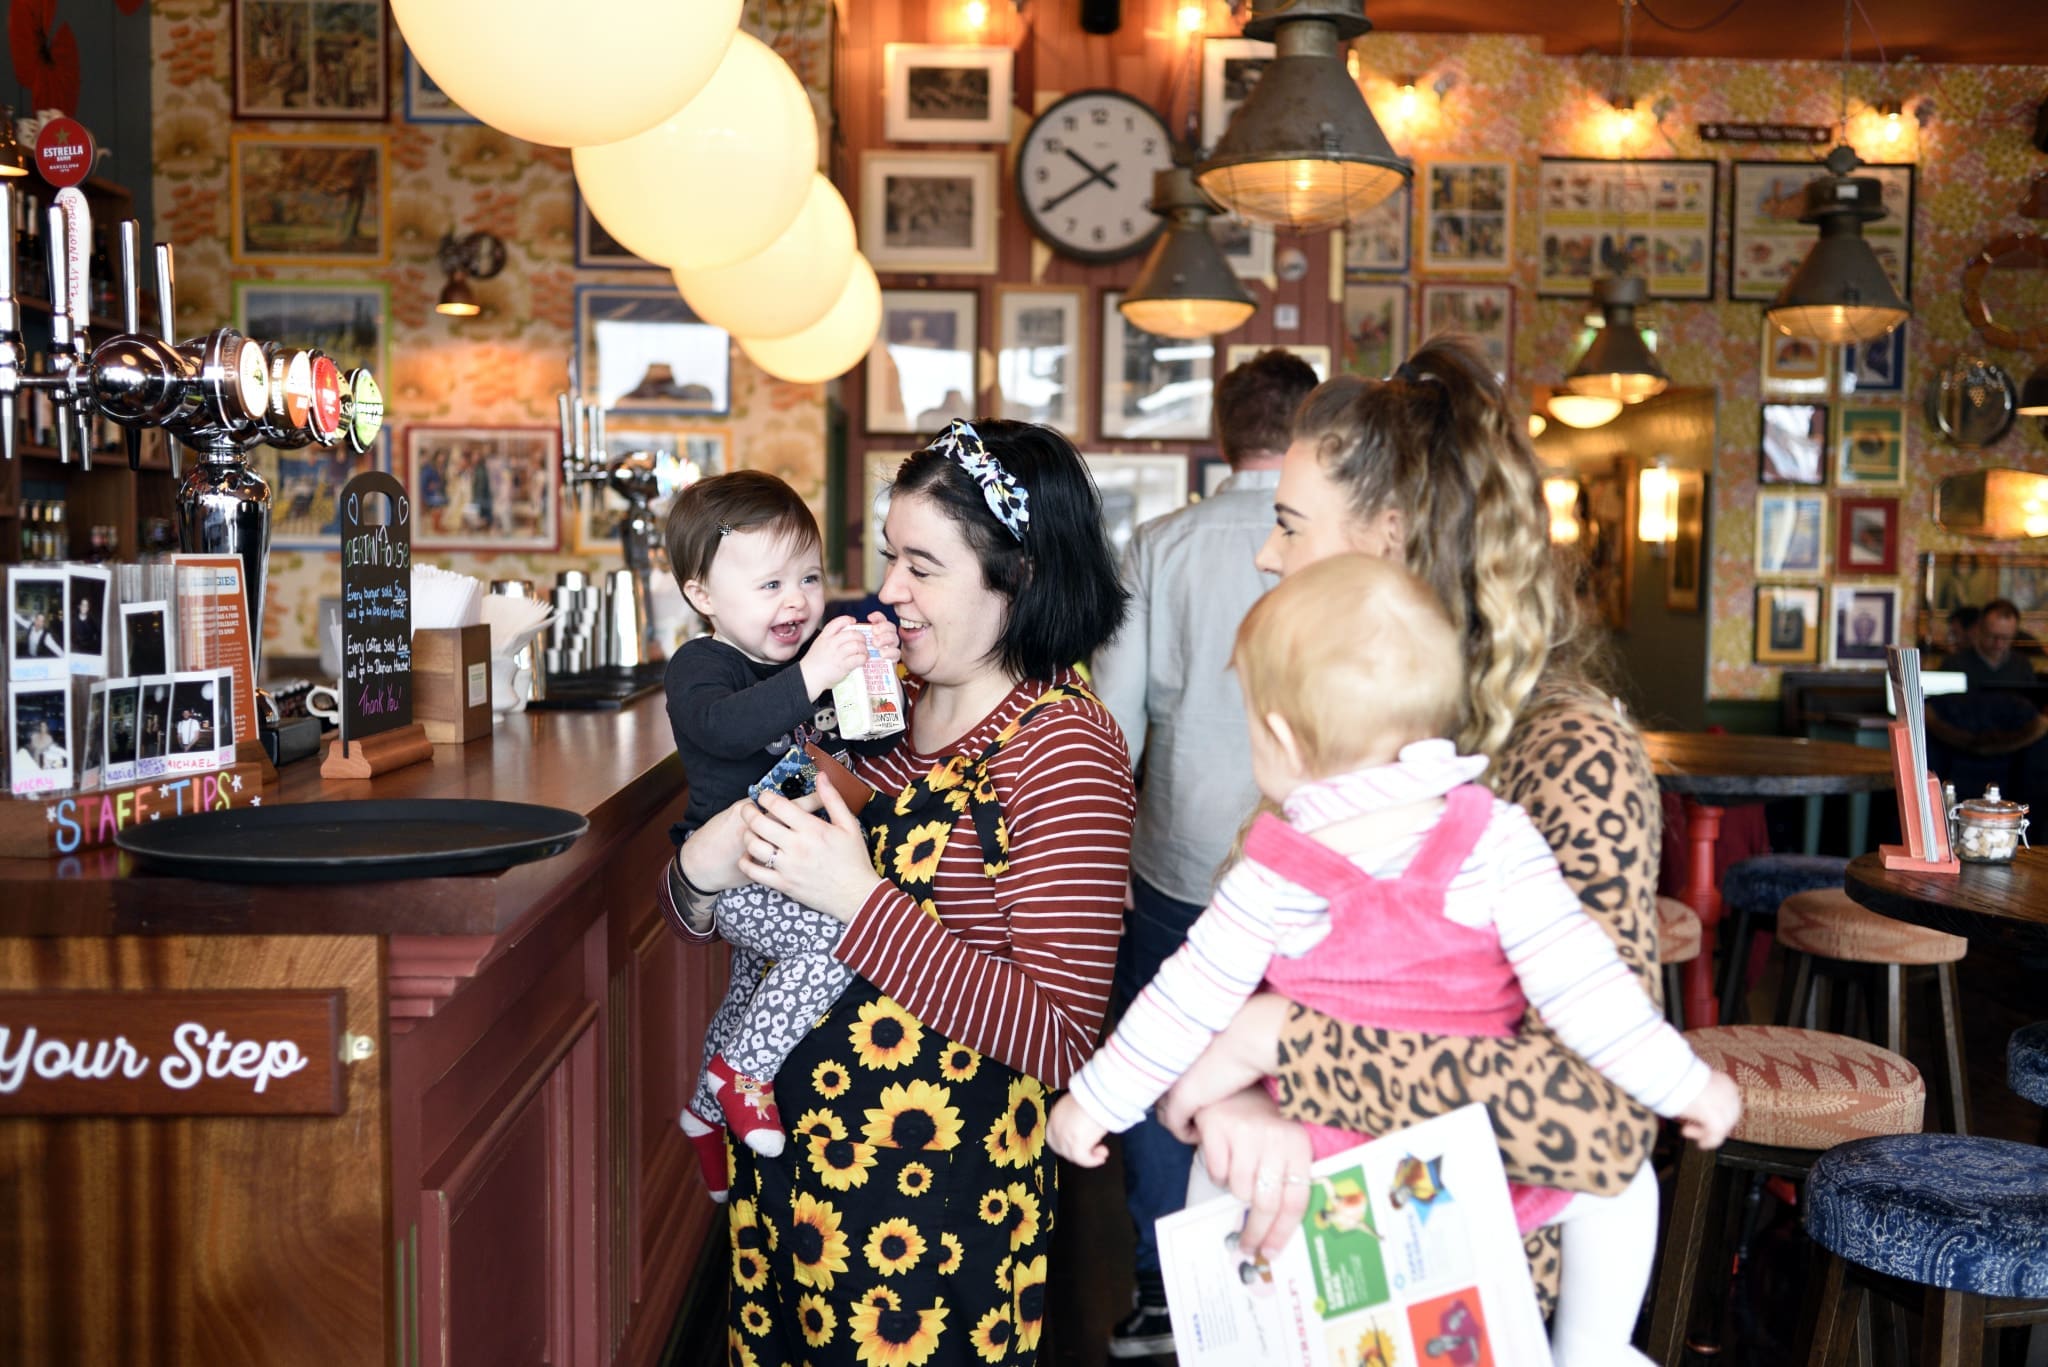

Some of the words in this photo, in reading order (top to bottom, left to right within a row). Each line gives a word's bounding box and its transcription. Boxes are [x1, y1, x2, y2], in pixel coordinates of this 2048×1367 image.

[43, 144, 84, 158] ESTRELLA
[347, 583, 363, 608] Every
[347, 634, 364, 666] Every
[358, 684, 384, 717] Thank
[55, 785, 152, 853] STAFF
[168, 771, 232, 817] TIPS
[0, 1026, 149, 1093] Your
[159, 1022, 308, 1093] Step
